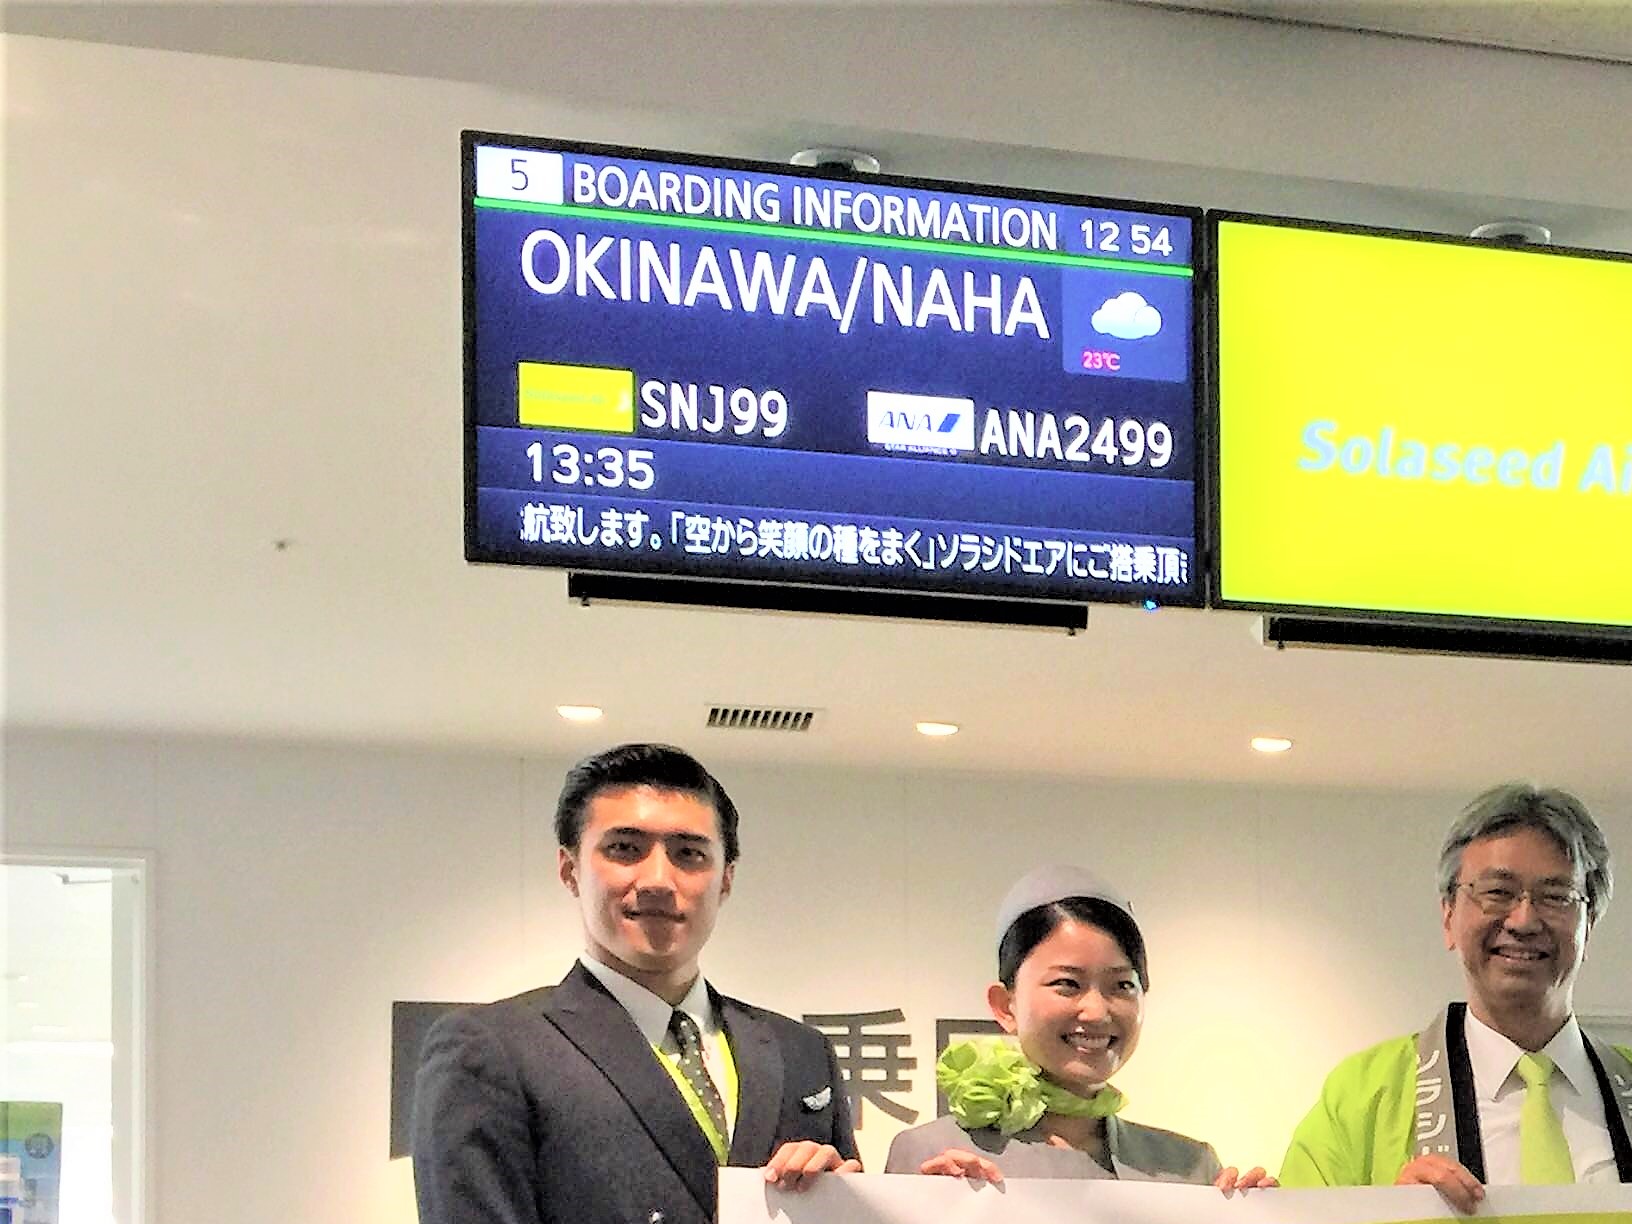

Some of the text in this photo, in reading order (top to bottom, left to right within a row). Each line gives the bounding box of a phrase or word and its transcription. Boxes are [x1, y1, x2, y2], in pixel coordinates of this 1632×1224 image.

[510, 158, 1172, 257] 5 BOARDING INFORMATION 12 54
[520, 228, 1050, 340] OKINAWA/NAHA
[641, 379, 788, 437] SNJ99
[879, 411, 932, 431] ANA
[981, 407, 1173, 468] ANA2499
[526, 442, 656, 491] 13:35
[1299, 419, 1565, 491] Solaseed
[520, 502, 1188, 585] 航致します。「空から笑顔の種をまく」ソラシドエアにご搭乗頂
[1416, 1049, 1449, 1156] ソラシ
